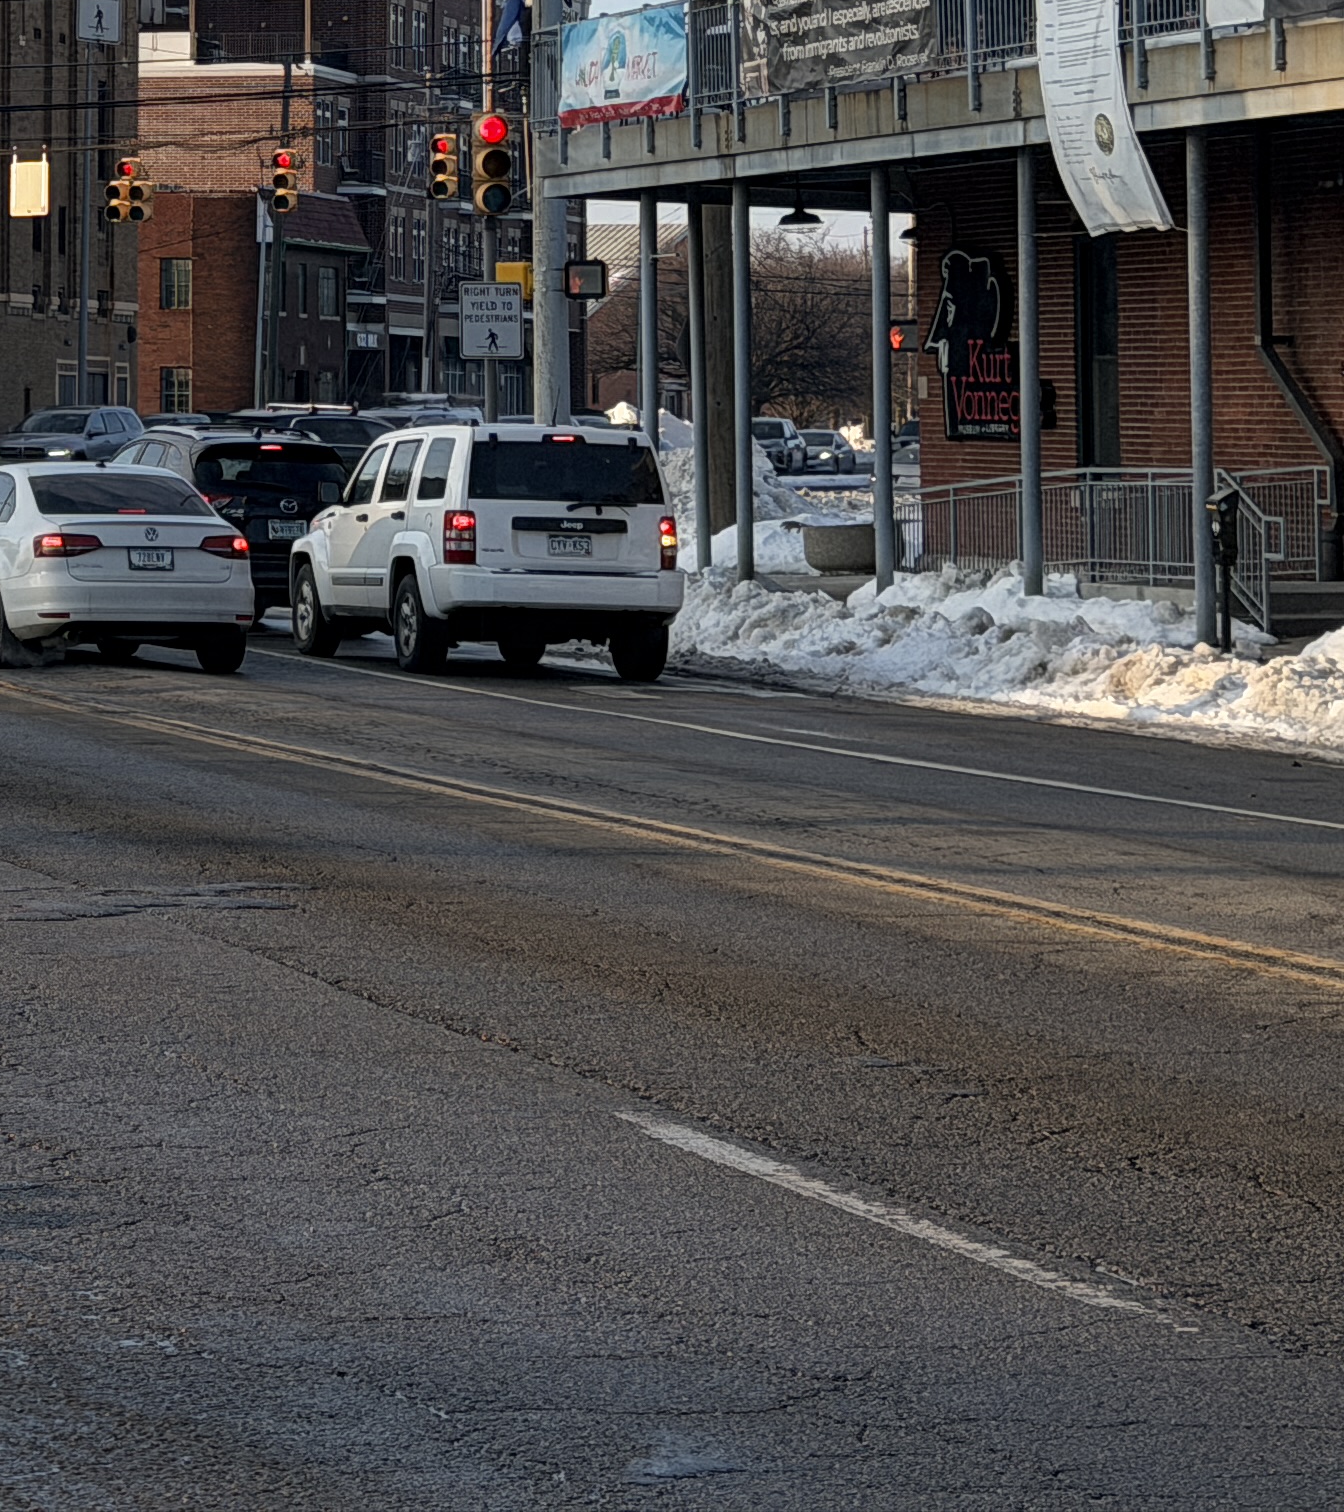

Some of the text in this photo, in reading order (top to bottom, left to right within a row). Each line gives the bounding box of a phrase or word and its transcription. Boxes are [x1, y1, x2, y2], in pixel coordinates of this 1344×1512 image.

[780, 13, 797, 33] and
[782, 42, 804, 61] from
[848, 29, 864, 50] and
[463, 287, 518, 297] RIGHT TURN
[470, 301, 513, 311] YIELD TO
[464, 314, 518, 324] PEDESTRIANS
[967, 339, 1012, 384] Kurt
[950, 376, 1020, 433] Vonneg
[560, 520, 583, 530] Jeep
